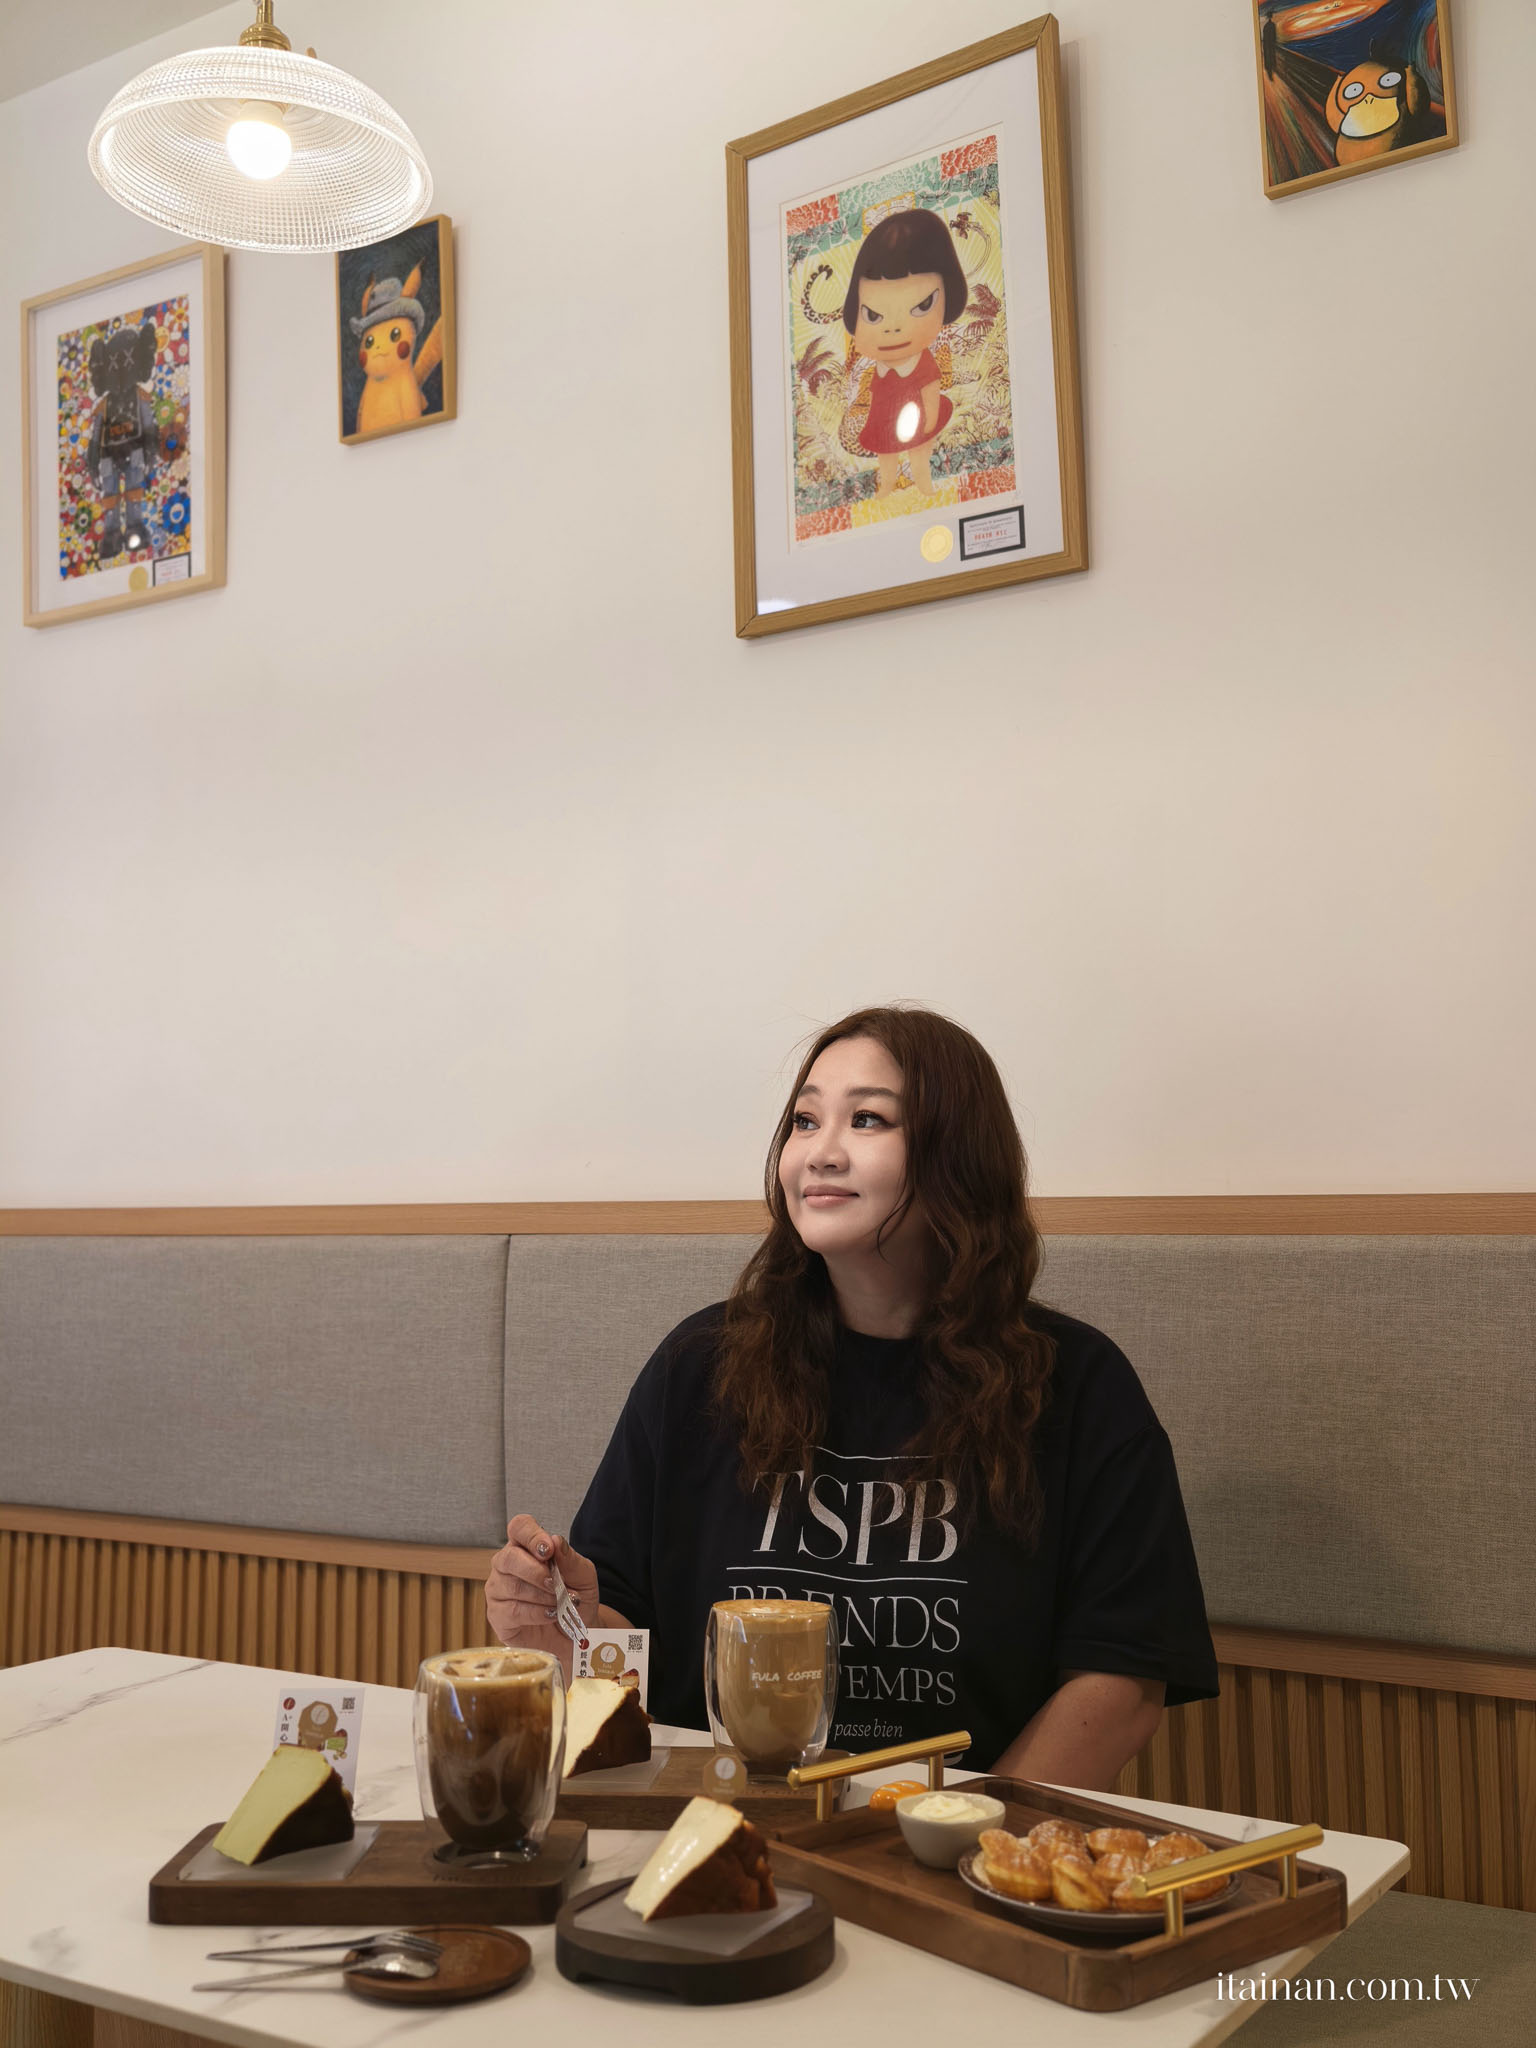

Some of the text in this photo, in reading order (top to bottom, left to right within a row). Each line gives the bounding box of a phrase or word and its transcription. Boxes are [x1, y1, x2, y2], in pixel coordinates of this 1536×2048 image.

[752, 1470, 958, 1565] TSPB
[728, 1585, 960, 1653] NDS
[751, 1669, 823, 1682] FULA COFFEE
[838, 1664, 957, 1706] EMPS
[834, 1717, 904, 1742] passe bien
